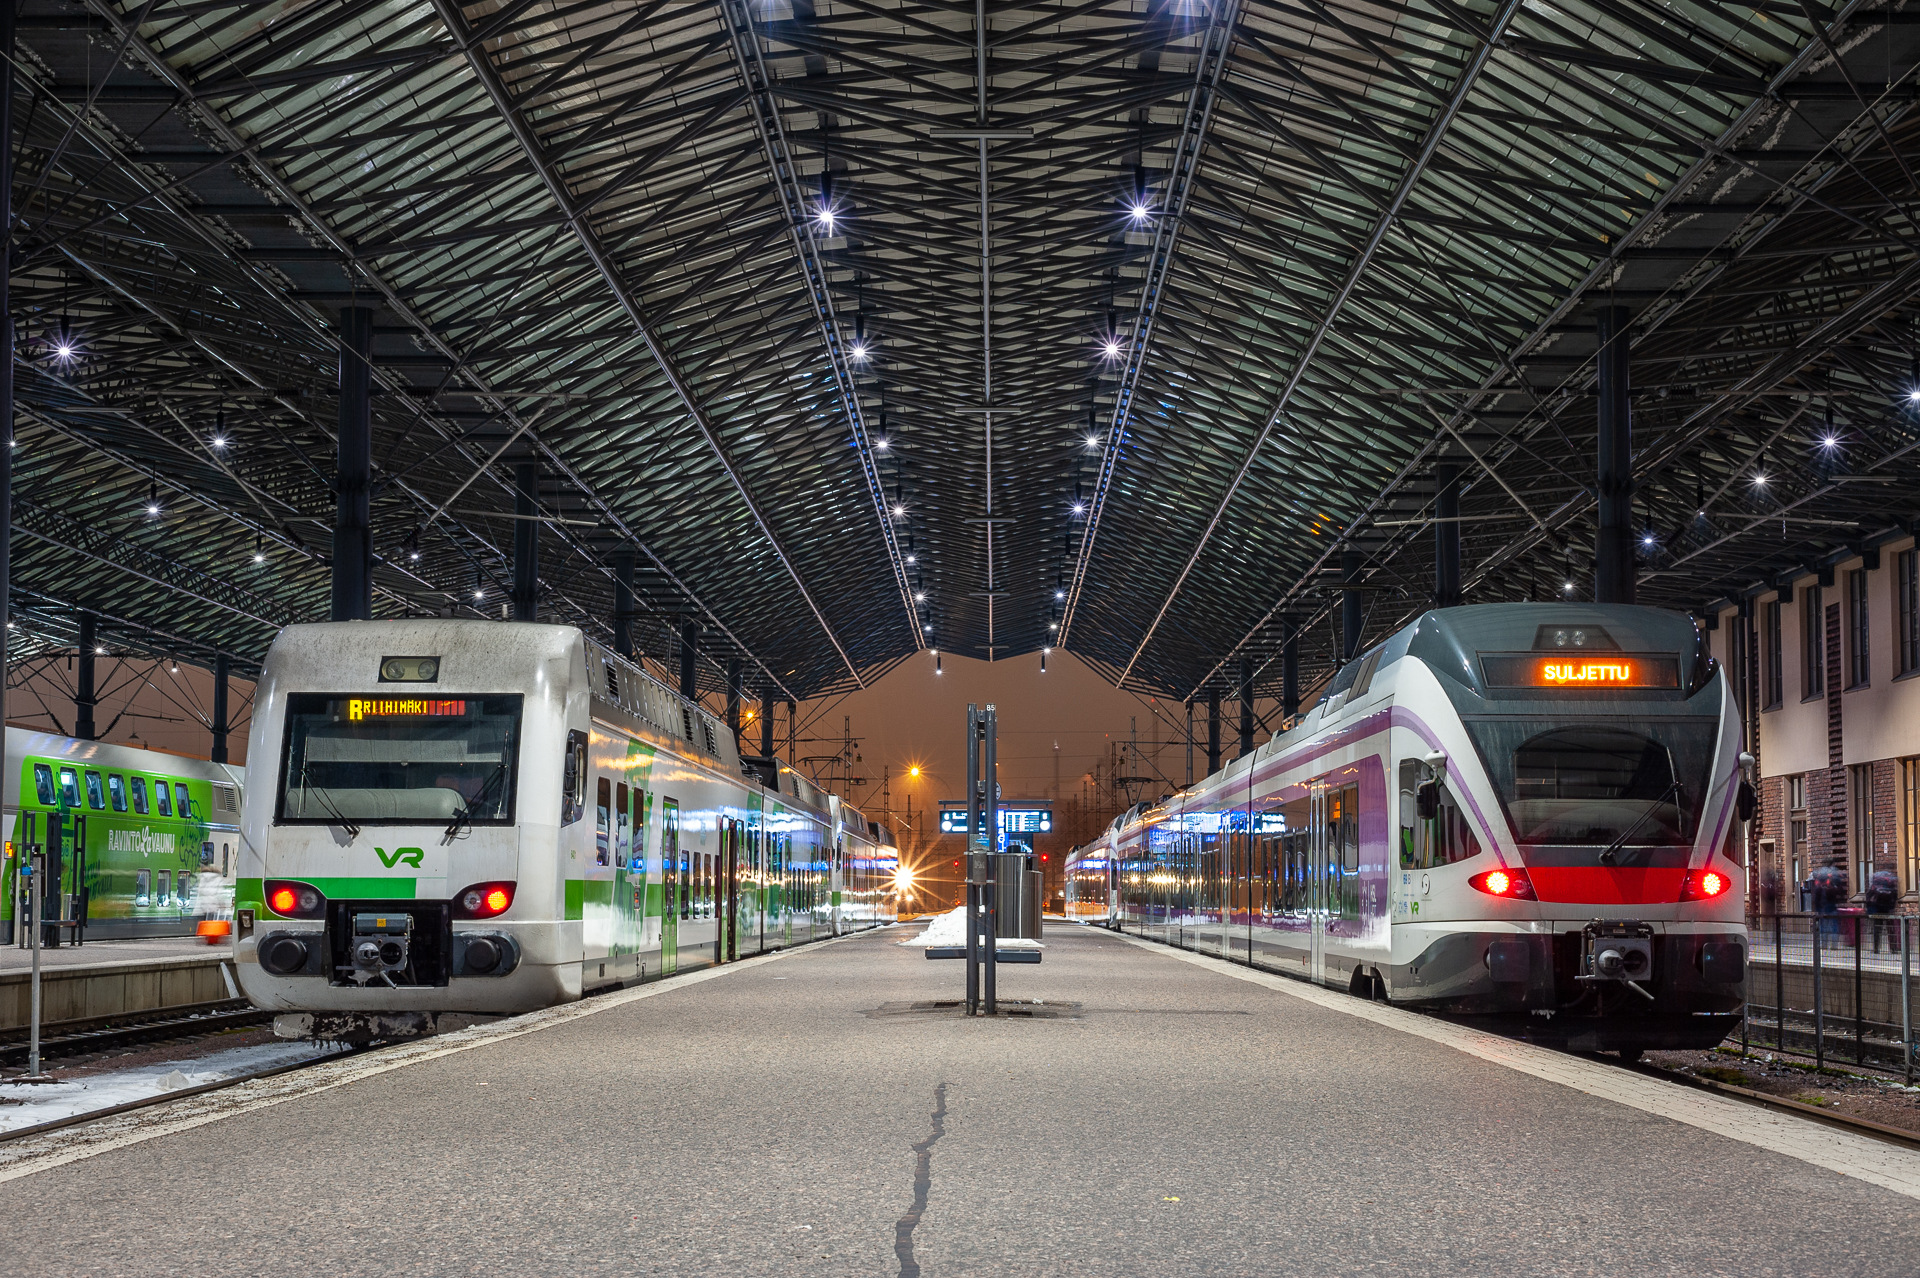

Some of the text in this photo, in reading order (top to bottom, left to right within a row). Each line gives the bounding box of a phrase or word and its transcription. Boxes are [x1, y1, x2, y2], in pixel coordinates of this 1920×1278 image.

[1544, 665, 1630, 681] SULJETTU
[349, 699, 427, 720] R RIIHIMÄKI
[373, 847, 425, 869] VR
[1410, 901, 1420, 915] VR
